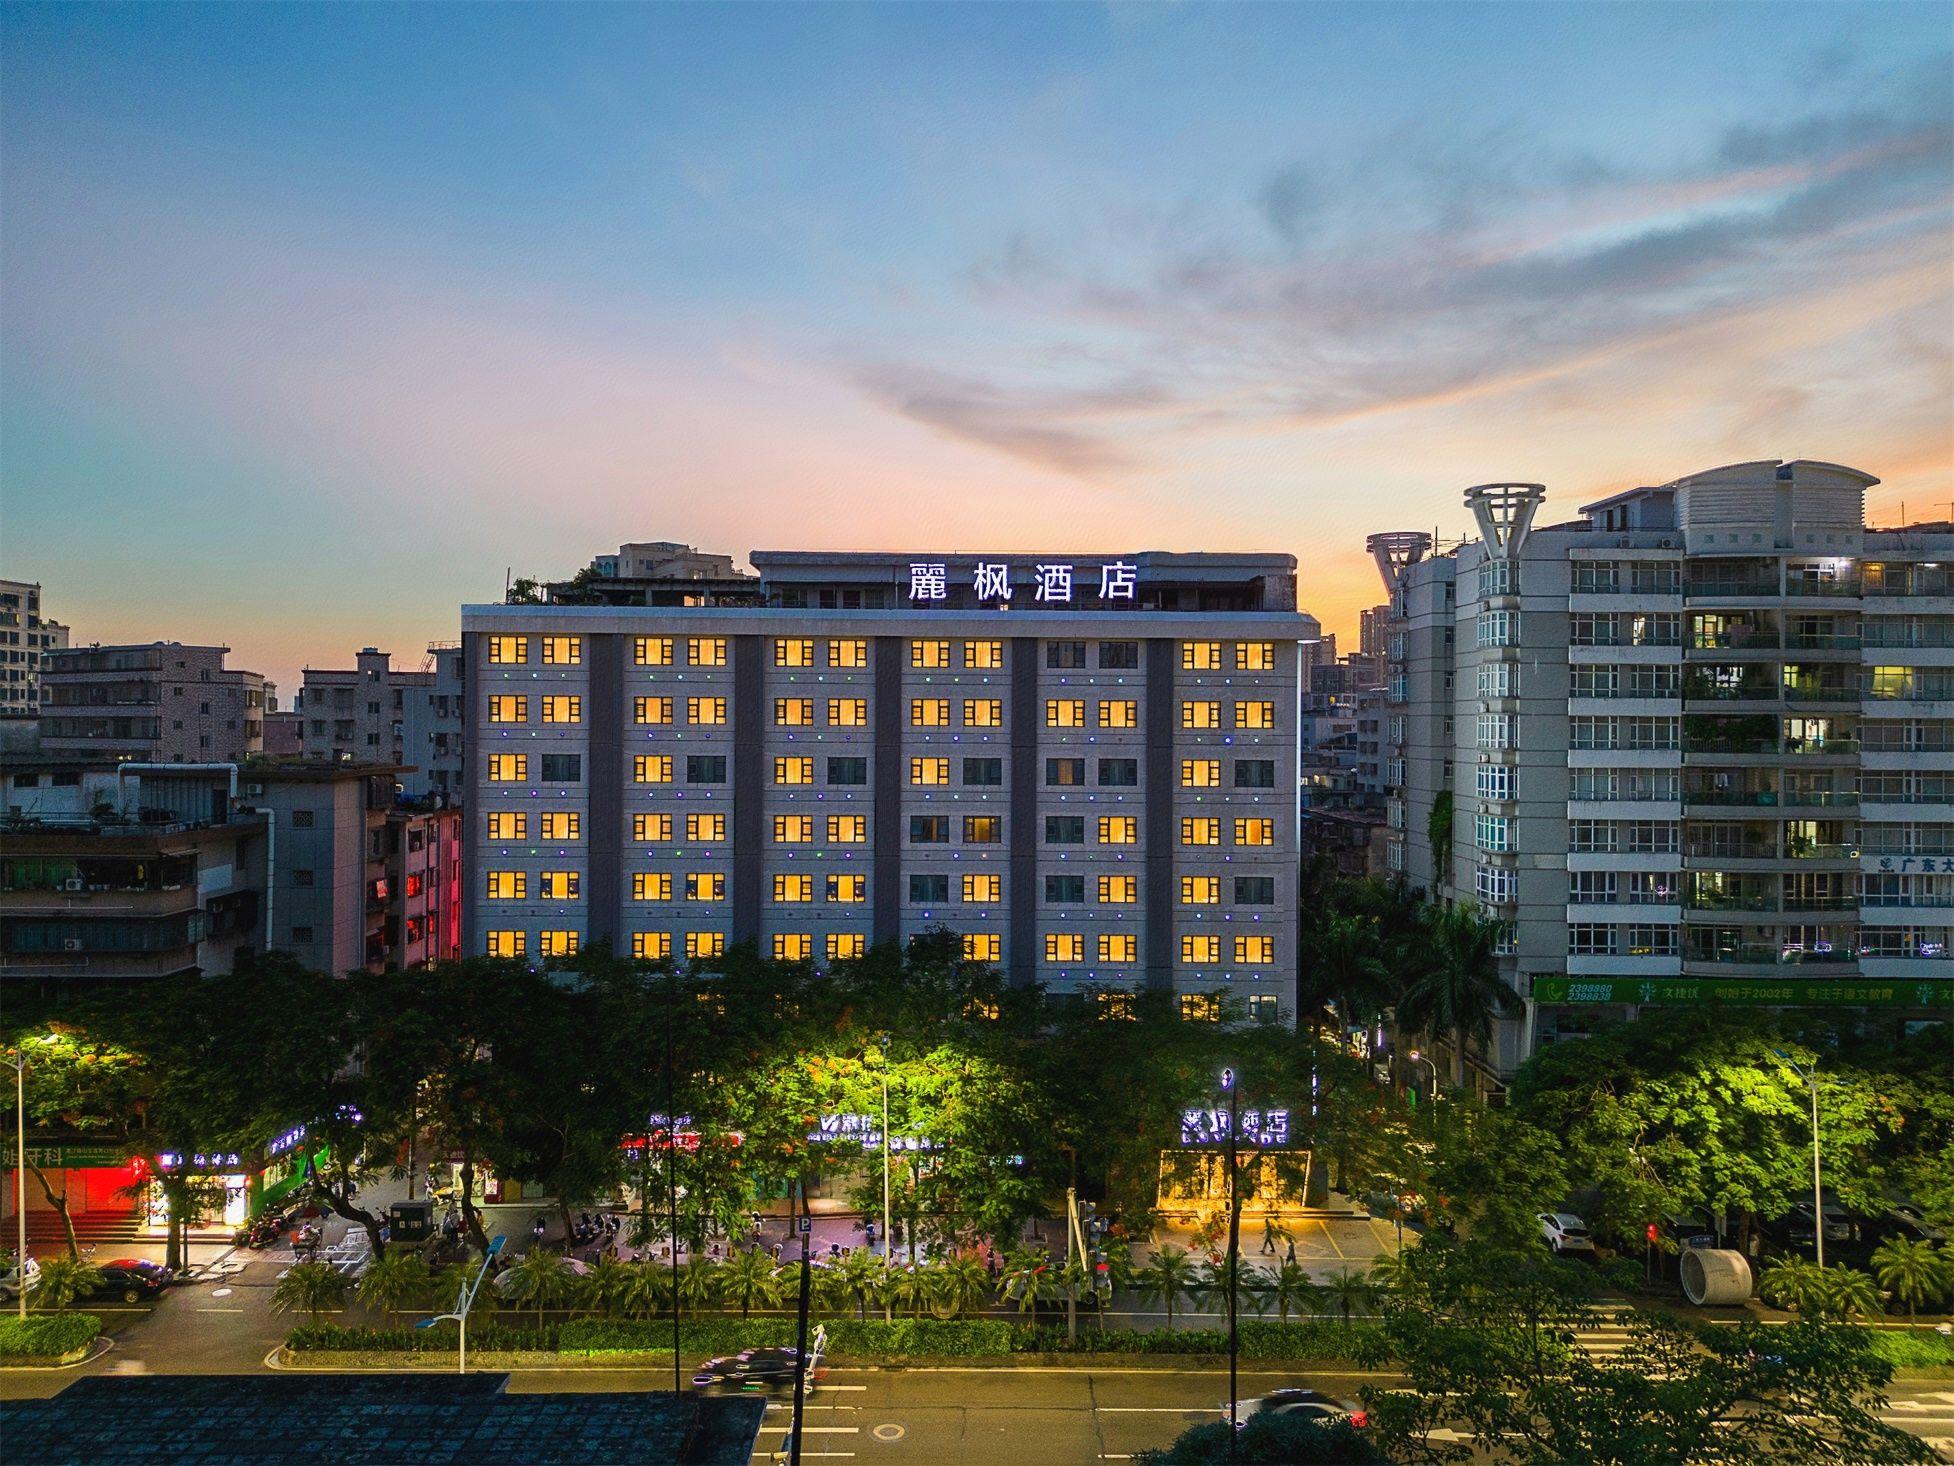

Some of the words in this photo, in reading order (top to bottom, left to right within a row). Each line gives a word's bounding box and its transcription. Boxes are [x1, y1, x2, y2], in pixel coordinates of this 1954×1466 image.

[908, 561, 1138, 602] 麗枫酒店
[801, 1218, 810, 1230] P
